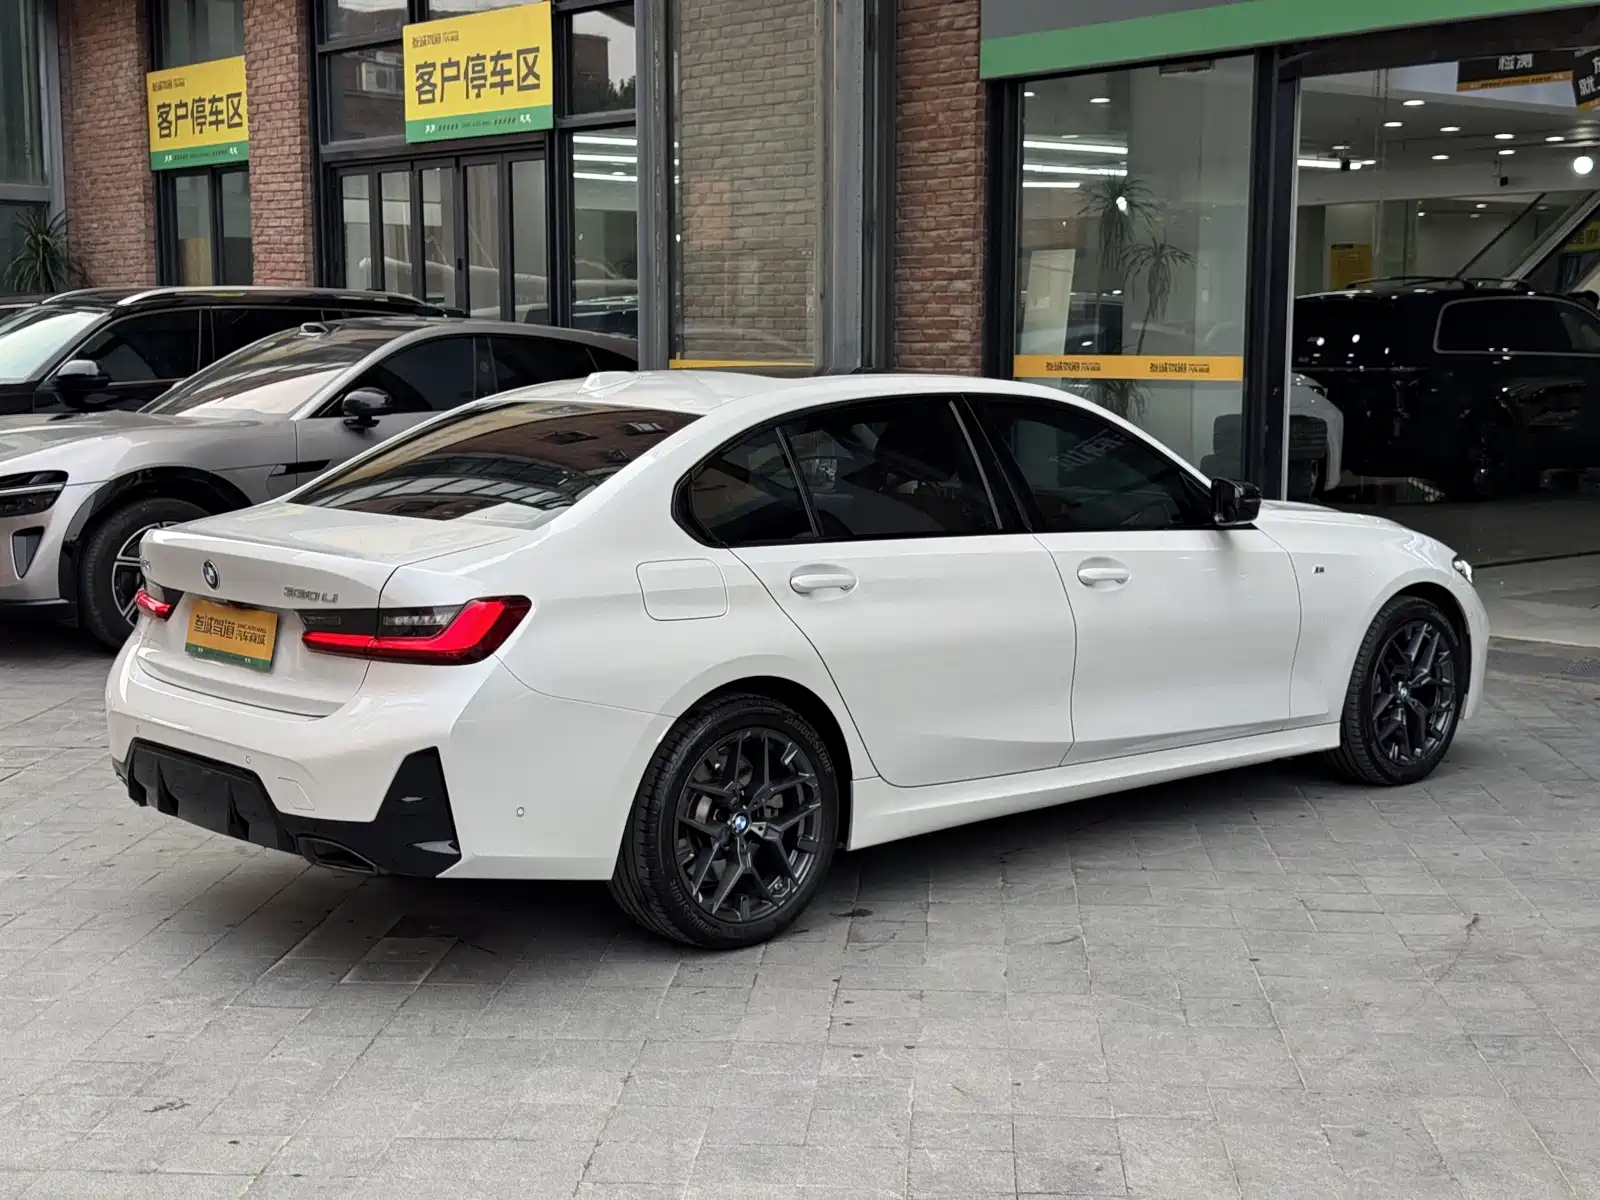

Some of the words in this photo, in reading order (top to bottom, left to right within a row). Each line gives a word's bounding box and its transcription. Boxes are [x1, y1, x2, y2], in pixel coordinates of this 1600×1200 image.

[416, 46, 540, 105] 客户停车区
[157, 92, 243, 139] 客户停车区
